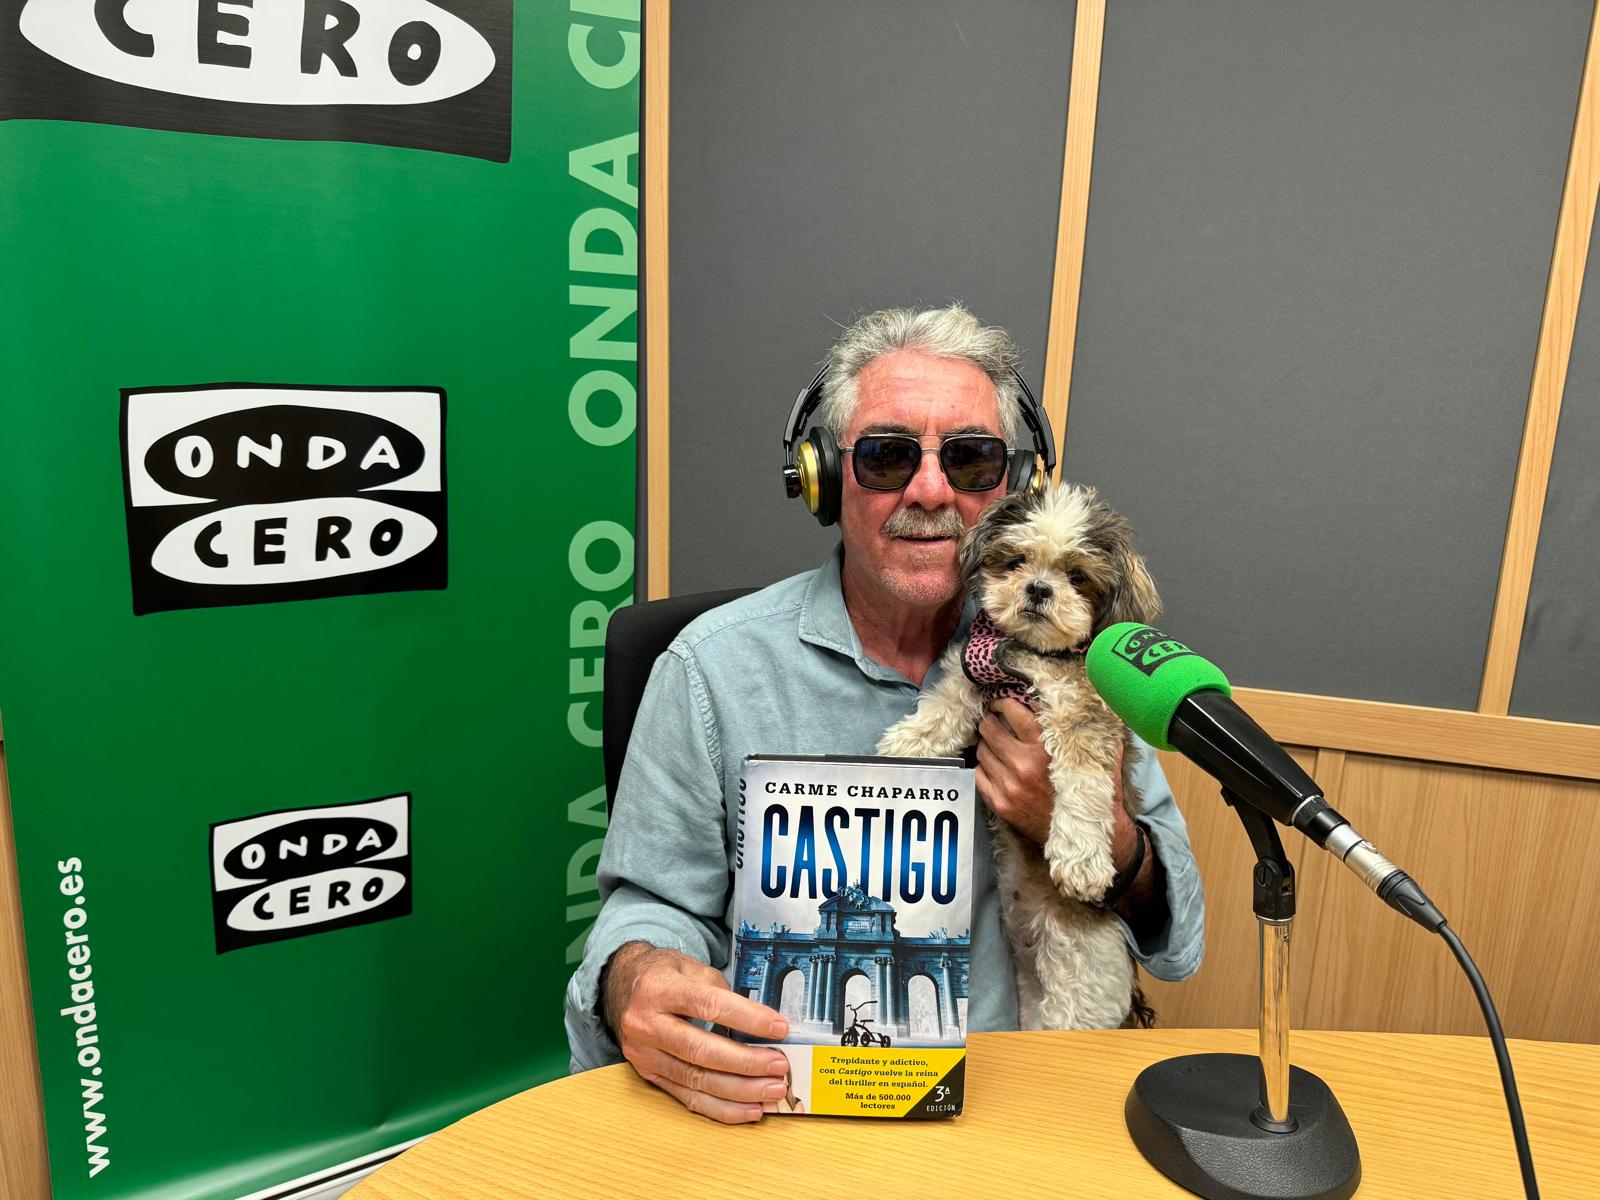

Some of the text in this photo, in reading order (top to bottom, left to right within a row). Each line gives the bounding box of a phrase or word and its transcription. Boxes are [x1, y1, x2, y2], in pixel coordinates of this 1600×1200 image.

[568, 132, 640, 447] ONDA
[174, 433, 401, 478] ONDA
[194, 515, 404, 569] CERO
[764, 781, 960, 802] CARME CHAPARRO
[240, 827, 383, 870] ONDA
[760, 803, 959, 905] CASTIGO
[252, 876, 385, 921] CERO
[57, 856, 111, 1179] www.ondacero.es
[819, 1067, 836, 1075] con
[838, 1067, 872, 1077] Castigo
[874, 1069, 903, 1077] vuelve
[905, 1069, 914, 1077] la
[830, 1056, 929, 1067] Trepidante y adictivo,
[828, 1078, 843, 1086] del
[845, 1078, 877, 1087] thriller
[891, 1081, 929, 1089] español.
[845, 1092, 912, 1101] Más de 500.000
[860, 1101, 896, 1110] lectores
[926, 1103, 957, 1112] EDICIÓN
